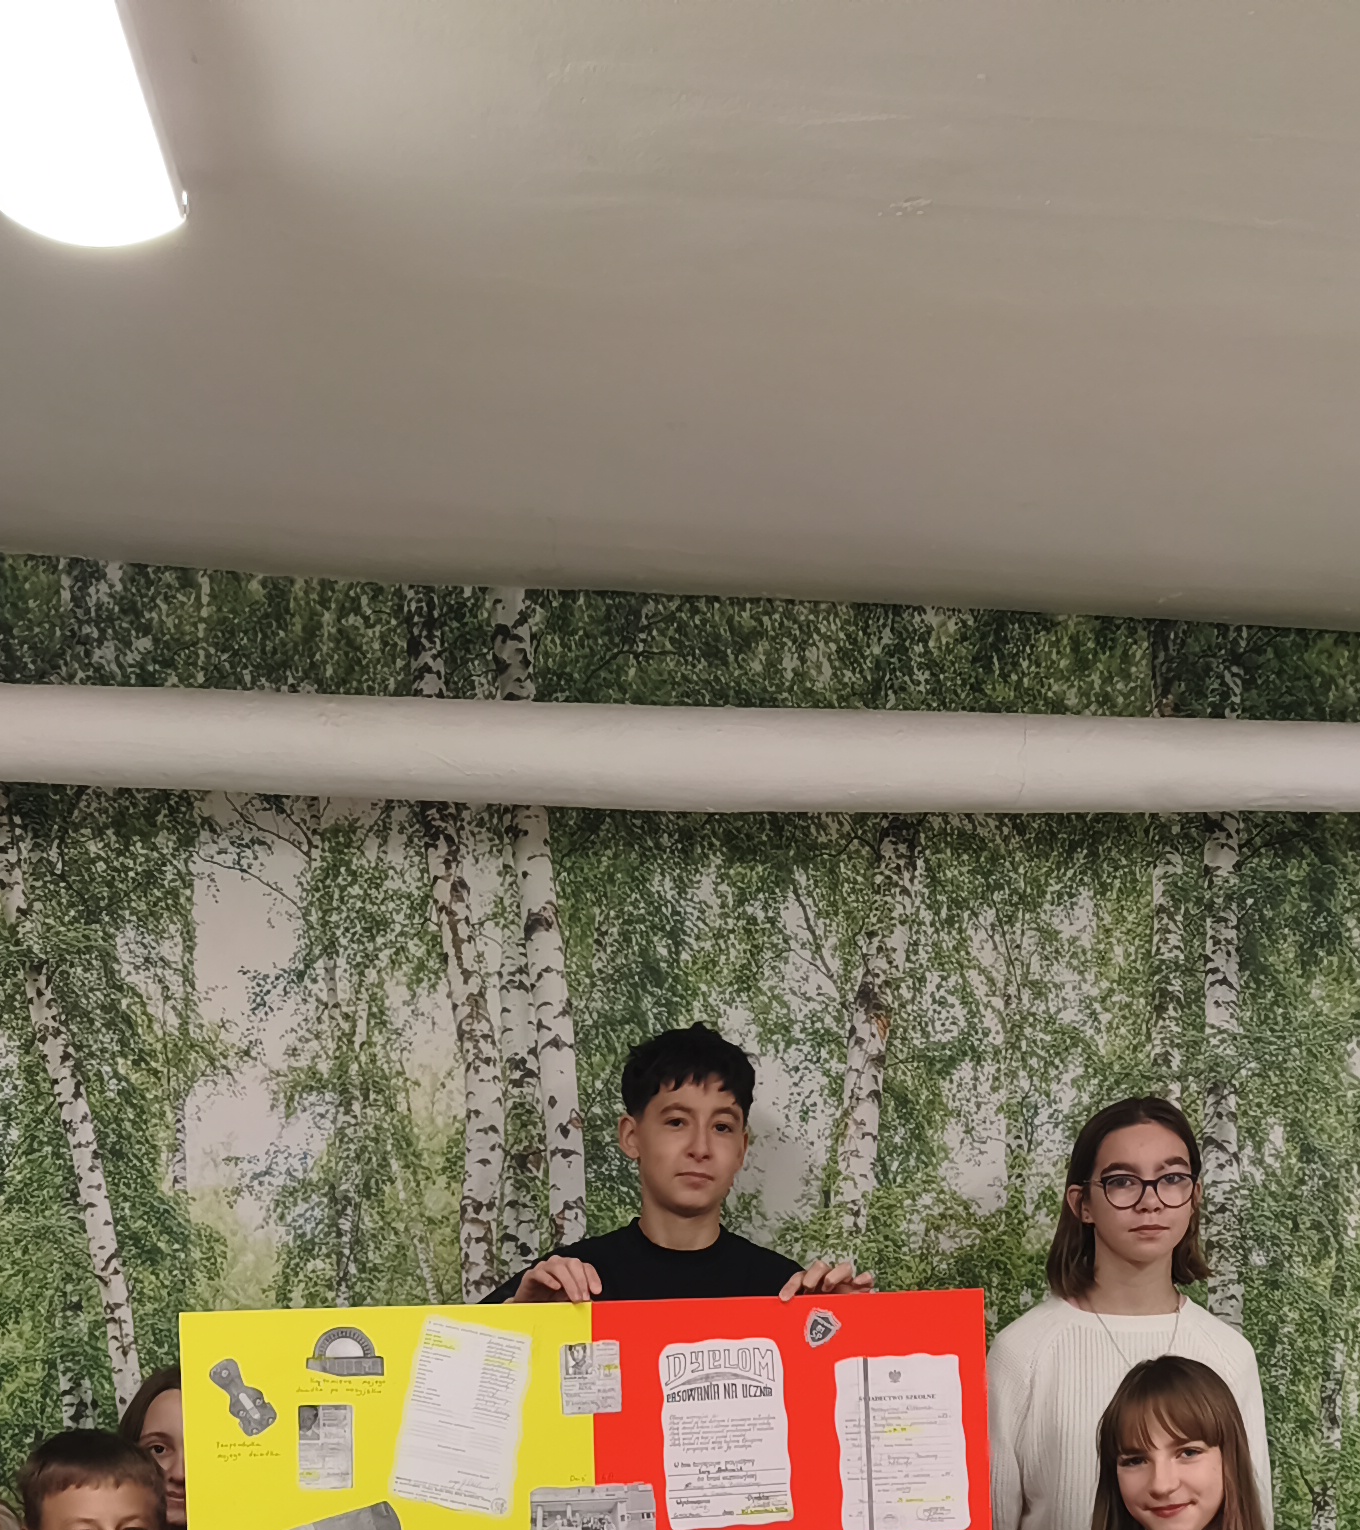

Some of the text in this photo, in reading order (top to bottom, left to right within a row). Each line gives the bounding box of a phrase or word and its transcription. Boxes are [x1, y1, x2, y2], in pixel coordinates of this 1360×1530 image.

[665, 1347, 775, 1386] DYPLOM
[666, 1382, 773, 1403] PASOWANIA NA UCZNIA
